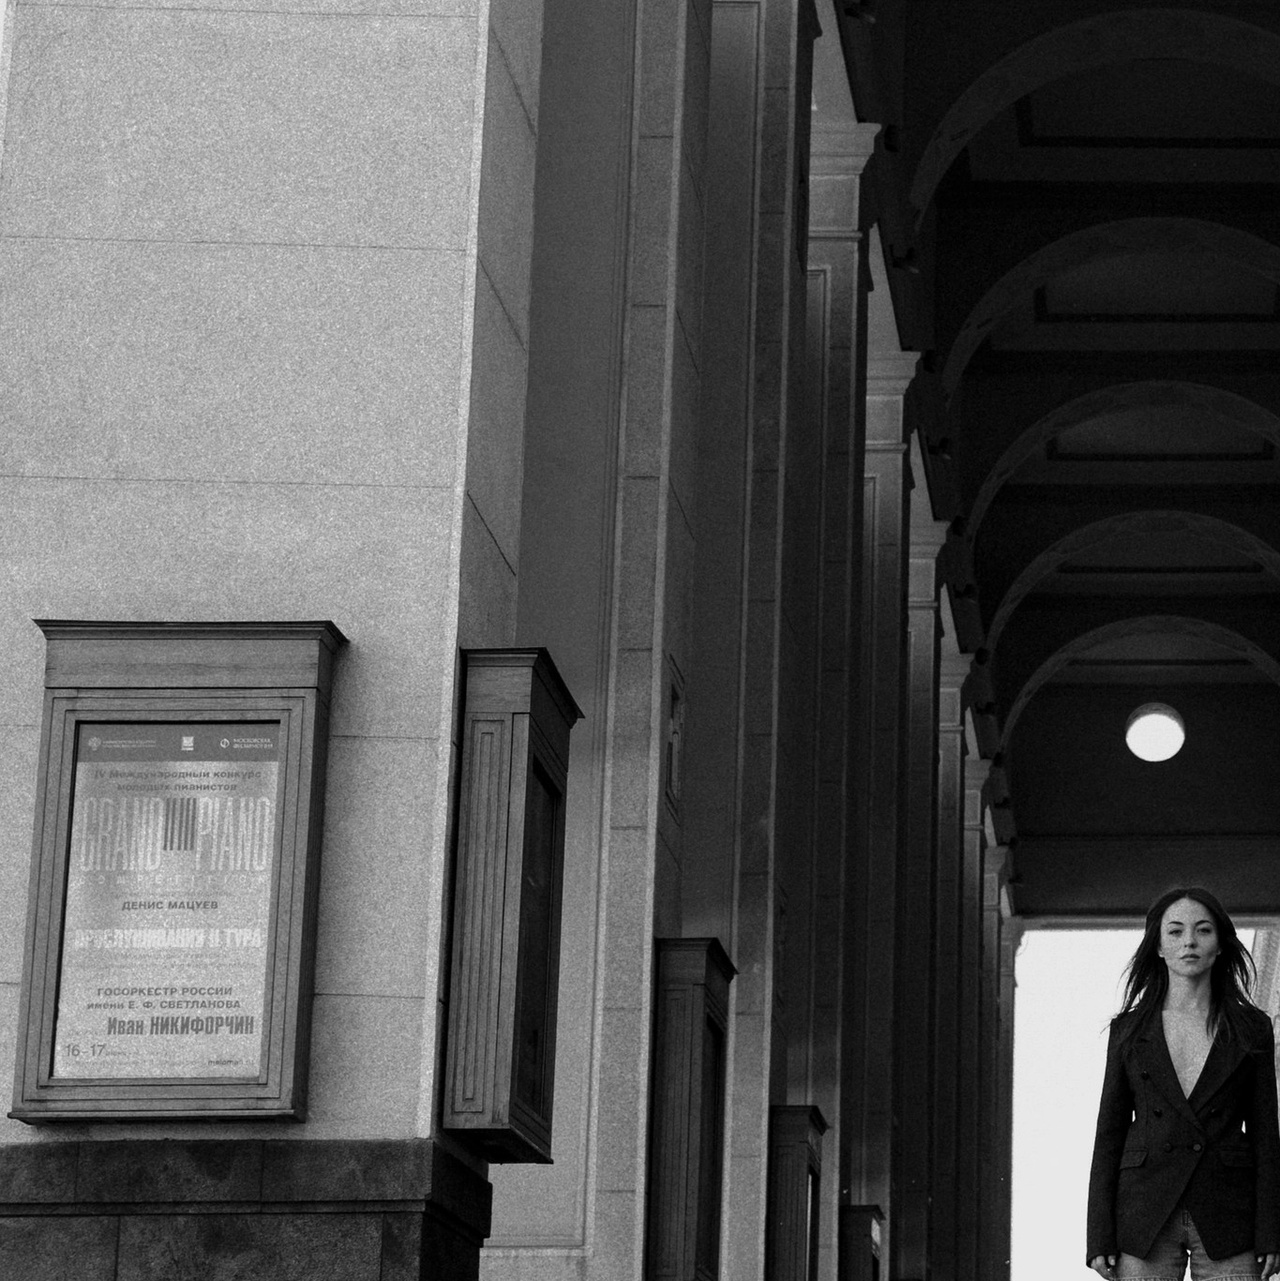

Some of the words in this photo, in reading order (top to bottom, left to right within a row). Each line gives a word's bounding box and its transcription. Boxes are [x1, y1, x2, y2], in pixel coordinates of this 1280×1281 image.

[213, 771, 262, 782] конкурс
[174, 784, 238, 792] пианистов
[80, 797, 164, 872] GRAND
[194, 797, 270, 872] PIANO
[121, 901, 164, 911] ДЕНИС
[167, 901, 218, 911] МАЦУЕВ
[97, 987, 177, 996] ГОСОРКЕСТР
[181, 987, 233, 996] РОССИИ
[87, 1001, 125, 1010] имени
[160, 1000, 241, 1009] СВЕТЛАНОВА
[107, 1017, 144, 1035] Иван
[150, 1016, 254, 1035] НИКИФОРЧИН
